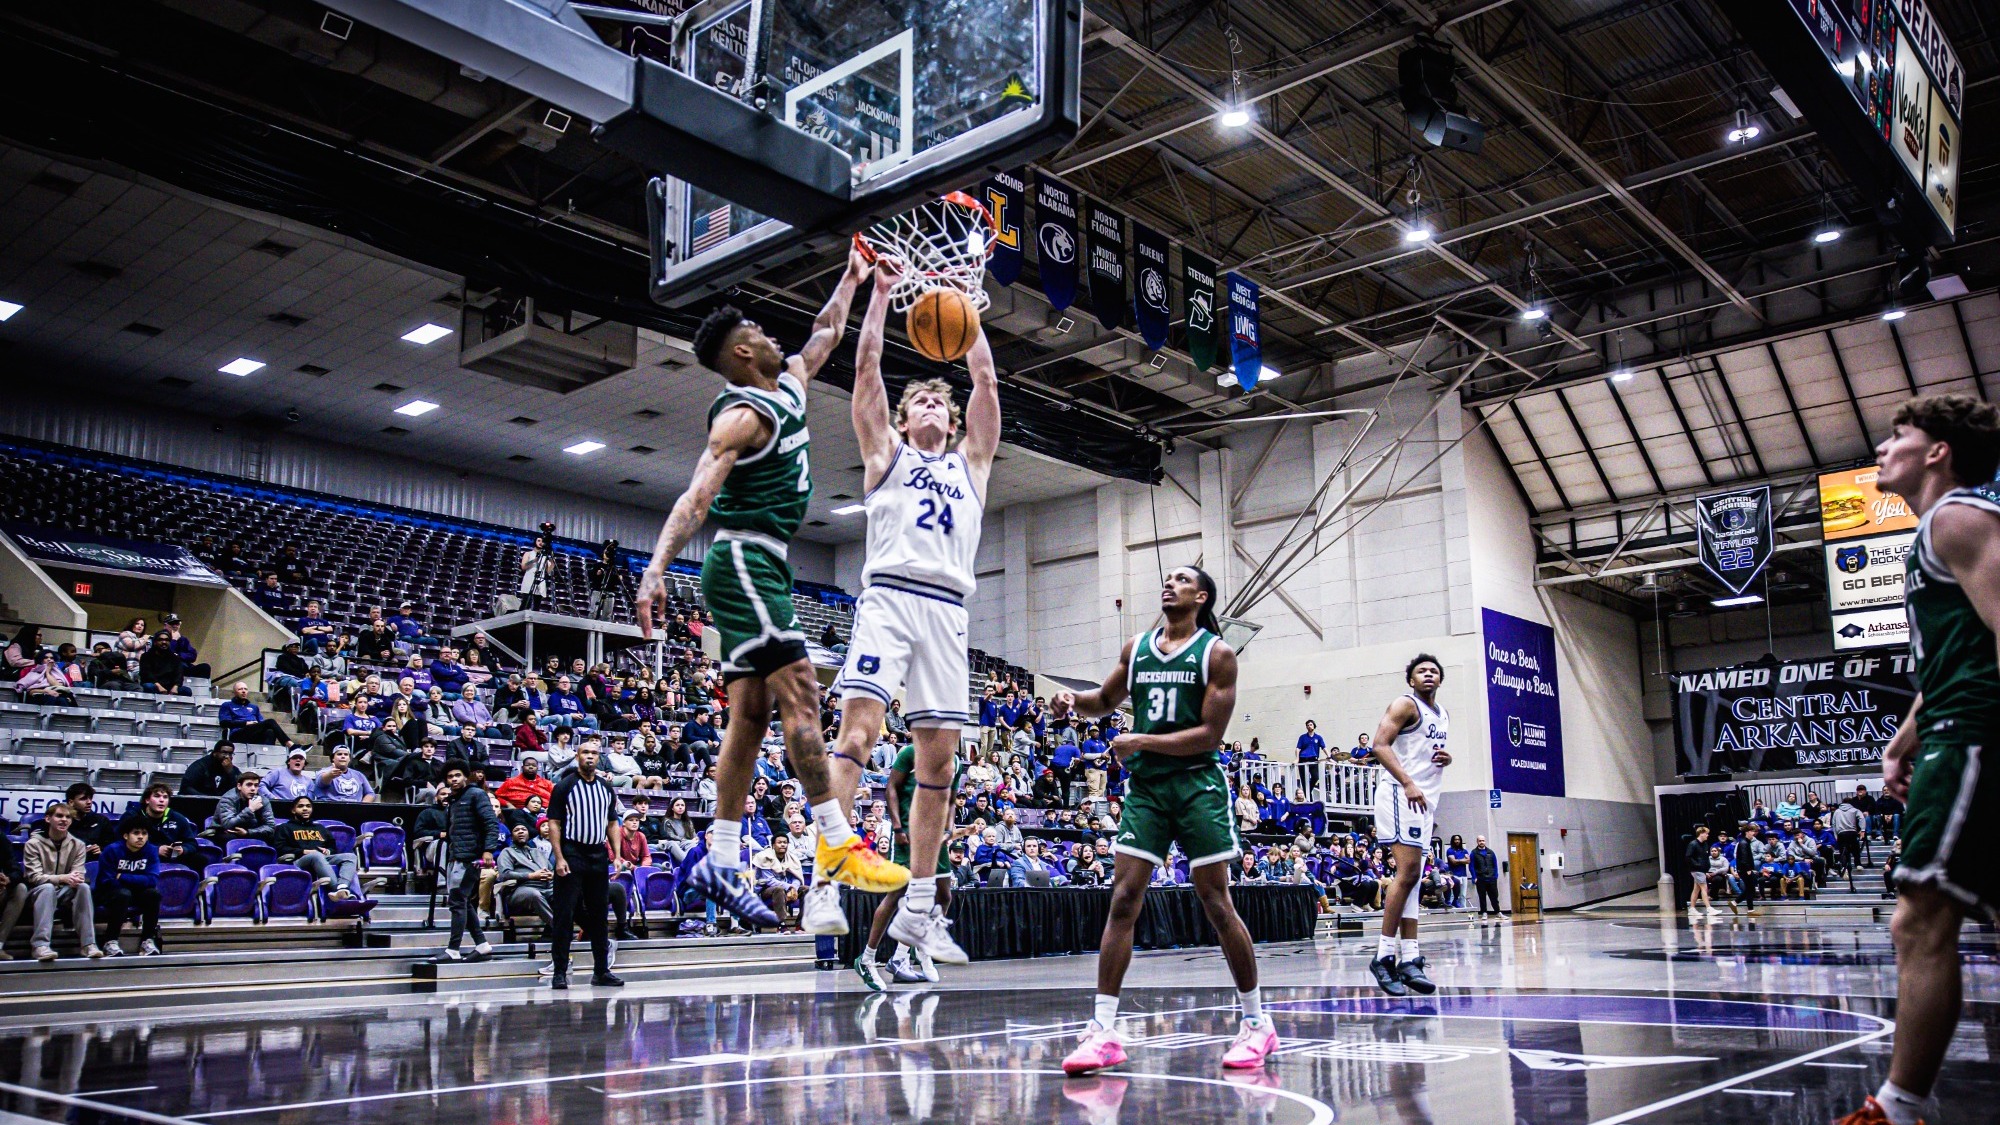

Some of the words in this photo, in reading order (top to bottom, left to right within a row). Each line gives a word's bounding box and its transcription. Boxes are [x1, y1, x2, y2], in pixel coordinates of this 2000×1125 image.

[715, 20, 749, 39] EASTE
[710, 28, 748, 57] KENTU
[791, 55, 824, 78] FLORI
[994, 172, 1025, 193] SCOMB
[1043, 183, 1069, 204] NORTH
[1038, 193, 1076, 219] ALABAMA
[1094, 209, 1118, 230] NORTH
[1091, 220, 1122, 244] FLORIDA
[1095, 245, 1117, 264] NORTH
[1139, 243, 1165, 264] QUEENS
[1187, 266, 1215, 288] STETSON
[1235, 282, 1251, 299] WEST
[1231, 291, 1257, 312] GEORGIA
[1234, 314, 1256, 342] UWG
[903, 467, 965, 500] Bears
[1710, 502, 1758, 516] ARKANSAS
[1713, 496, 1754, 508] CENTRAL
[915, 498, 955, 536] 24
[1713, 536, 1759, 550] TAYLOR
[1715, 527, 1756, 538] basketball
[1720, 546, 1754, 571] 22
[1870, 548, 1891, 557] THE
[1895, 545, 1909, 554] UC
[1871, 553, 1907, 566] BOOKS
[75, 583, 91, 595] EXIT
[1843, 579, 1866, 591] GO
[1871, 573, 1904, 588] BEA
[1867, 621, 1910, 632] Arkansa
[1489, 641, 1510, 664] Once
[1510, 652, 1518, 666] a
[1517, 648, 1540, 674] Bear,
[1136, 671, 1197, 684] JACKSONVILLE
[1491, 667, 1526, 697] Always
[1526, 679, 1534, 692] a
[1532, 675, 1555, 697] Bear.
[1678, 667, 1770, 693] NAMED
[1779, 661, 1834, 684] ONE
[1843, 657, 1880, 679] OF
[1147, 687, 1179, 722] 31
[1731, 690, 1877, 722] CENTRAL
[1523, 726, 1546, 740] ALUMNI
[1712, 715, 1898, 753] ARKANSAS
[1796, 748, 1884, 765] BASKETBA
[0, 797, 9, 815] T
[117, 858, 148, 872] BEARS
